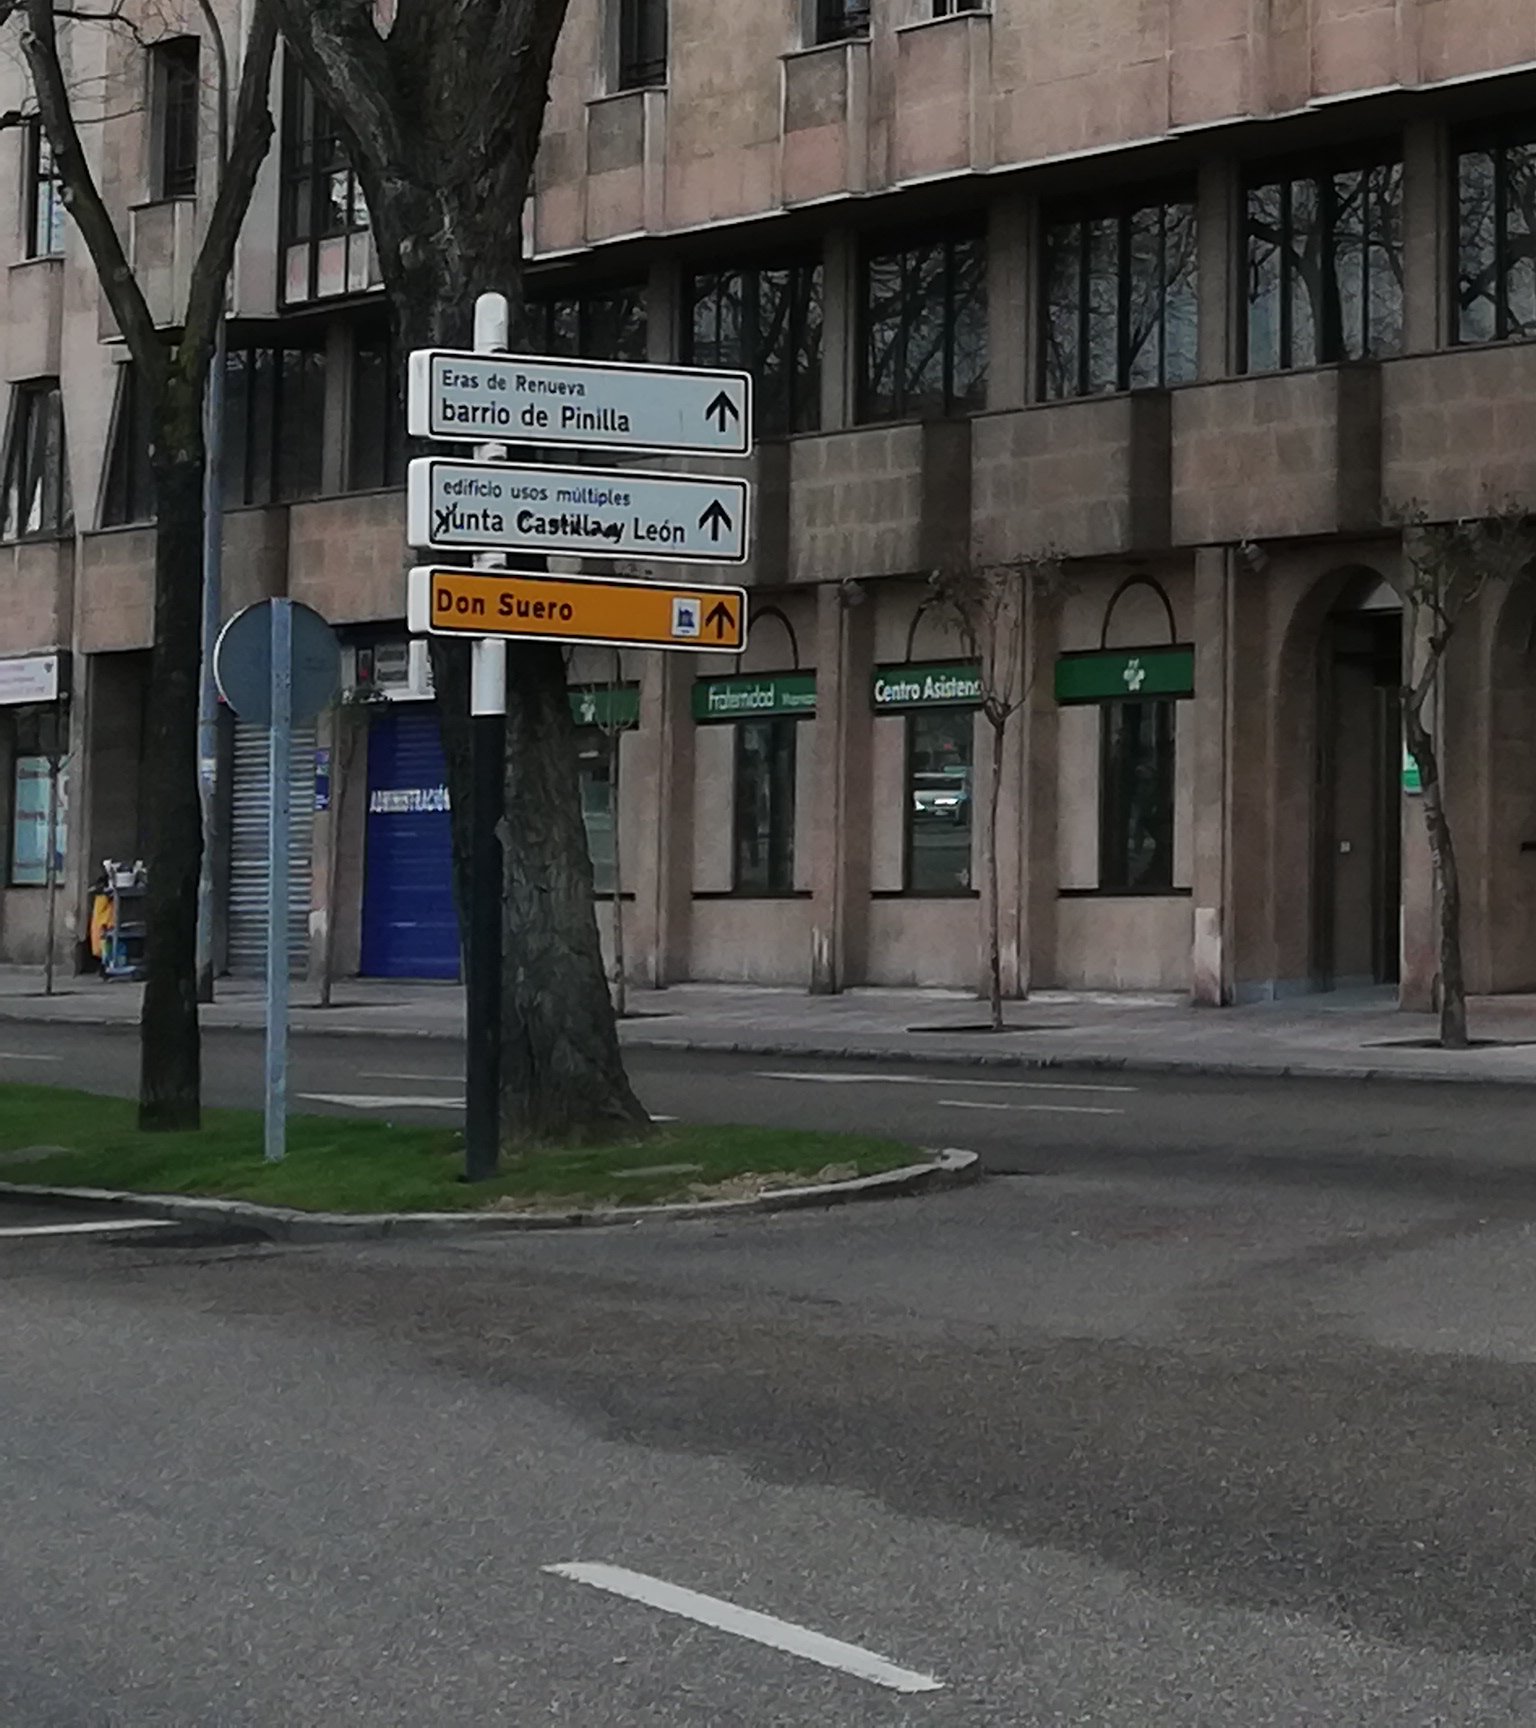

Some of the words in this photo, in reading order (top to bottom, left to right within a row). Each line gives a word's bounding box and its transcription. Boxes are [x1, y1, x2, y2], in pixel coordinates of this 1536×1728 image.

[442, 370, 479, 389] Eras
[487, 374, 506, 390] de
[516, 375, 586, 396] Renueva
[442, 398, 510, 424] barrio
[521, 403, 548, 427] de
[561, 406, 631, 432] Pinilla
[443, 480, 502, 498] edificio
[511, 486, 548, 501] usos
[557, 487, 631, 507] múltiples
[634, 518, 685, 543] León
[437, 589, 485, 616] Don
[498, 593, 573, 621] Suero
[874, 679, 920, 702] Centro
